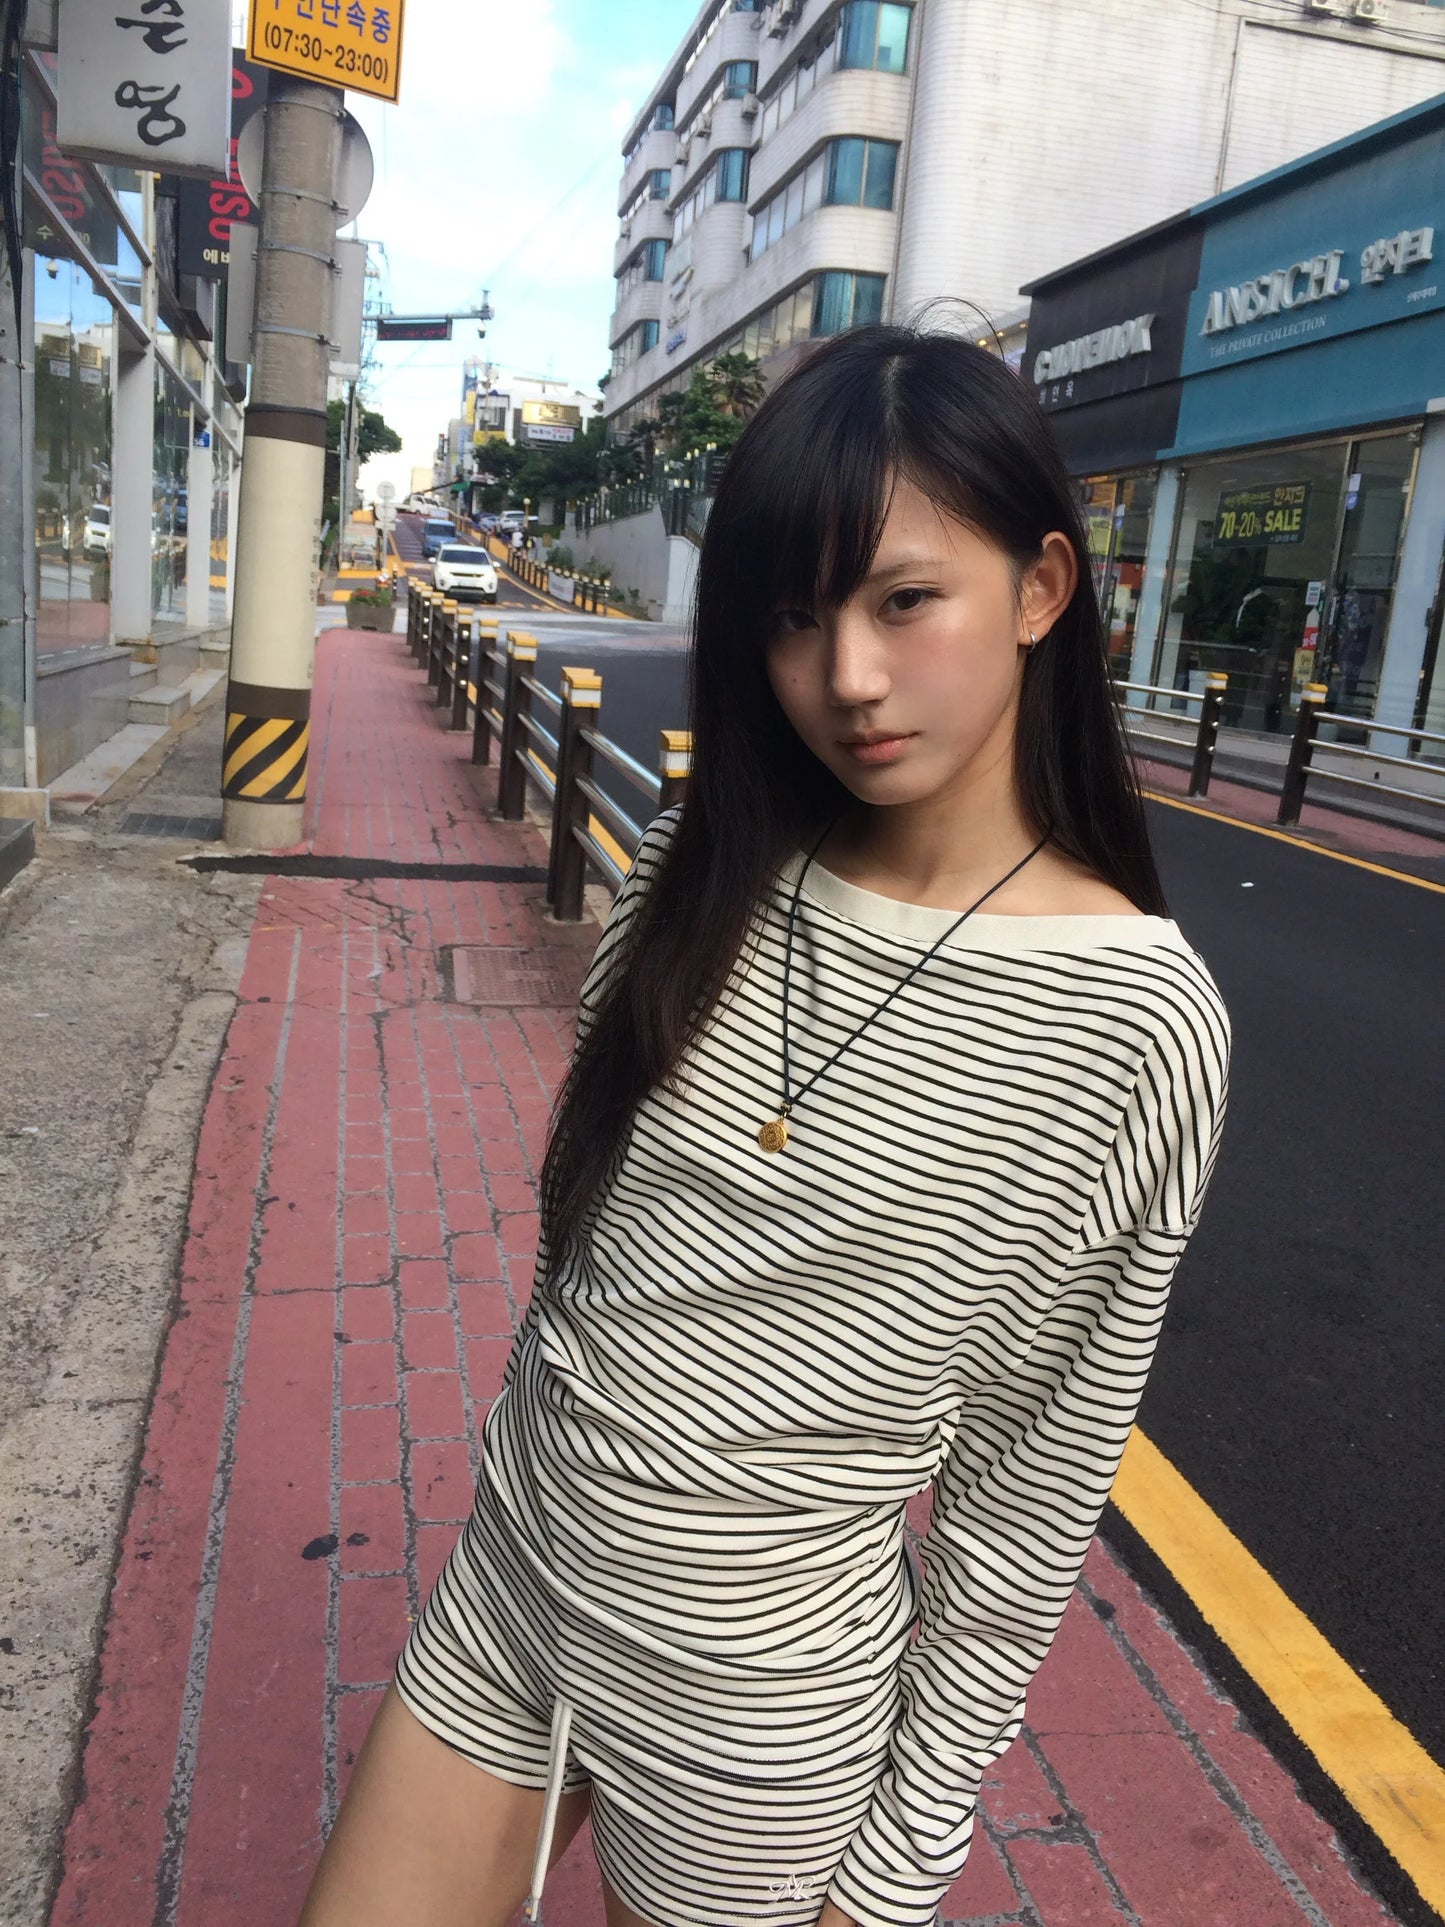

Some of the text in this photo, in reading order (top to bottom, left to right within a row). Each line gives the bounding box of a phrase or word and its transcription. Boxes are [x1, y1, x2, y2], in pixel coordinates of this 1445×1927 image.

[273, 0, 391, 44] 인단속중
[265, 22, 389, 84] (07:30~23:00)
[1208, 314, 1327, 359] THE PRIVATE COLLECTION
[1264, 508, 1302, 532] SALE
